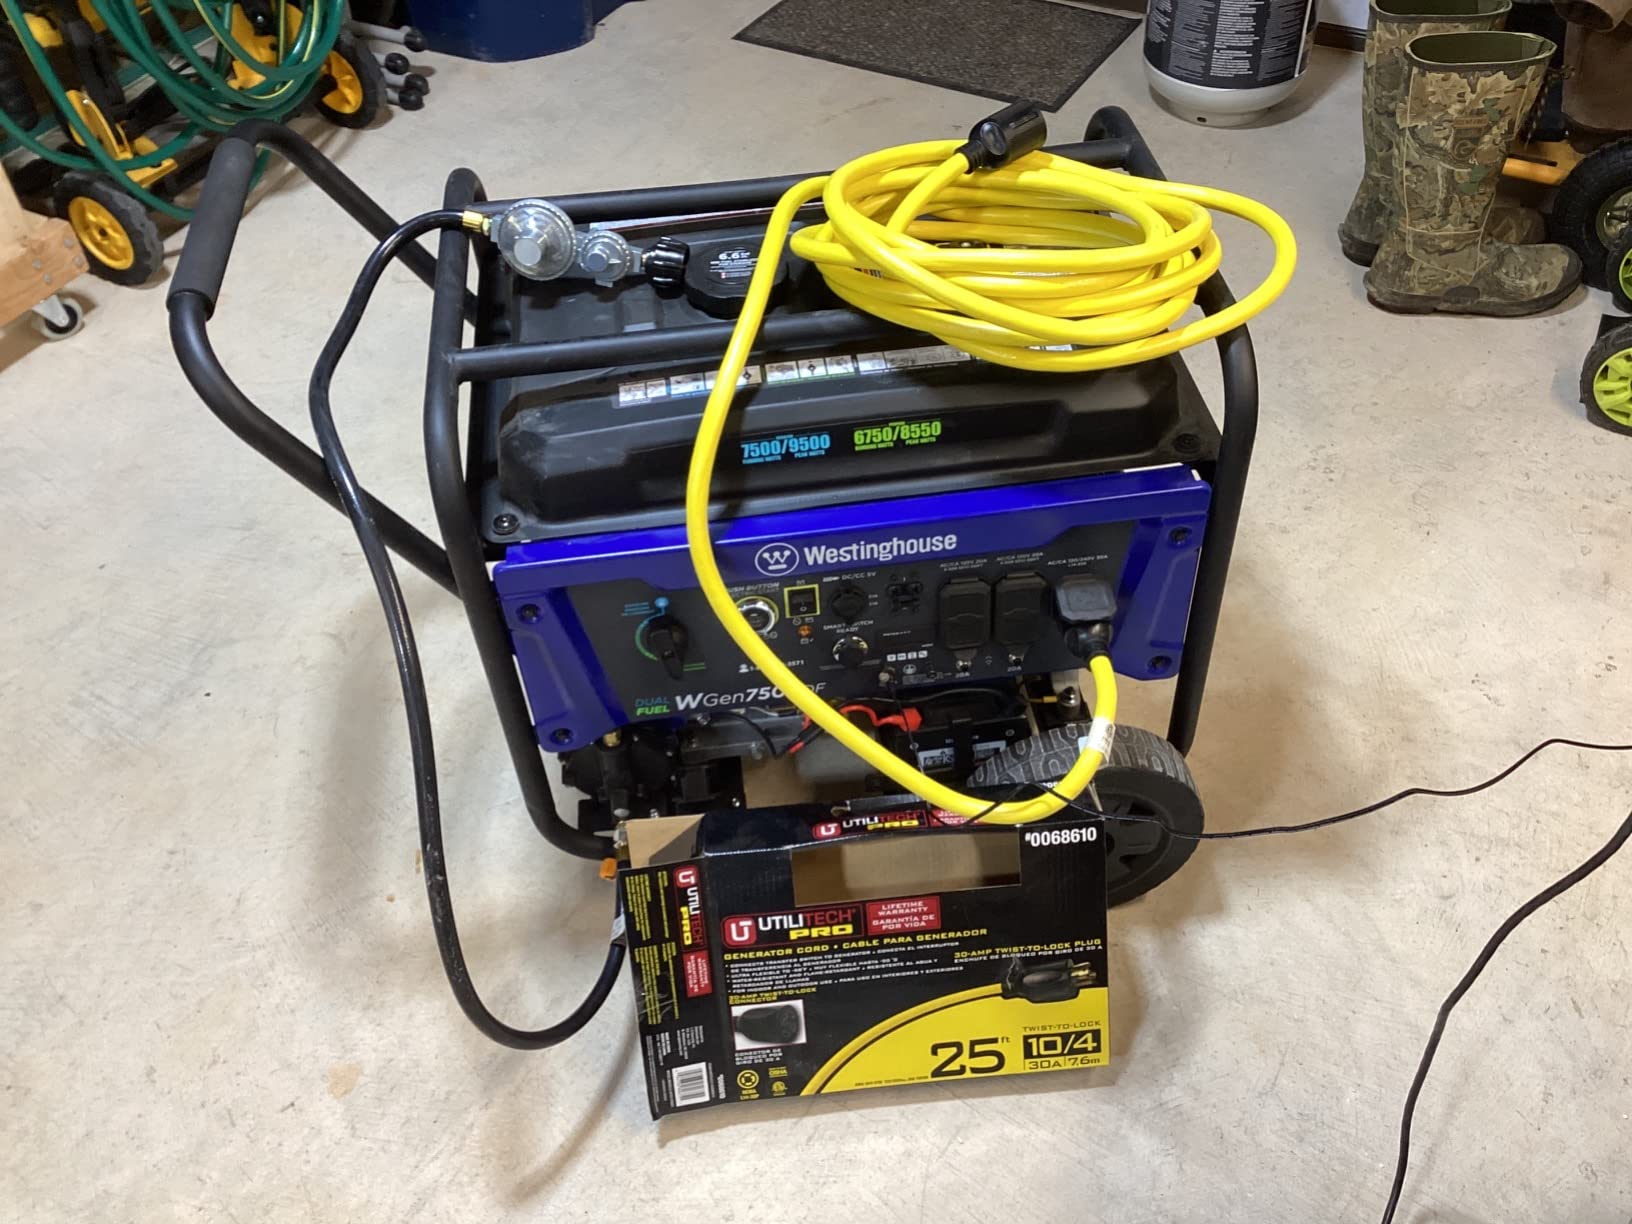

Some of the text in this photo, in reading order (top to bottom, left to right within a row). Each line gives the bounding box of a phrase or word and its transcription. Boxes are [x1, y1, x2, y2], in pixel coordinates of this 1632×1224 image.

[718, 252, 740, 260] 6.6
[854, 421, 942, 445] 6750/8550
[740, 434, 831, 458] 7500/9500
[803, 533, 957, 567] Westinghouse
[635, 696, 670, 708] DUAL
[636, 705, 671, 716] FUEL
[867, 818, 920, 831] PRO
[1024, 826, 1097, 848] #0068610
[877, 906, 929, 917] WARRANTY
[881, 900, 924, 911] LIFETIME
[680, 905, 692, 946] PRO
[872, 913, 936, 926] GARANTÍA DE
[882, 920, 928, 930] POR VIDA
[789, 923, 854, 941] PRO
[842, 928, 988, 950] CABLE PARA GENERADOR
[916, 941, 960, 950] INTERRUPTOR
[954, 938, 1102, 959] 30-AMP TWIST-TO-LOCK PLUG
[723, 944, 830, 961] GENERATOR CORD
[954, 954, 988, 963] ENCHUFE
[1001, 951, 1036, 959] BLOQUEO
[759, 987, 817, 997] TWIST-TO-LOCK
[728, 996, 778, 1005] CONNECTOR
[1022, 1020, 1102, 1033] TWIST-TO-LOCK
[1000, 1035, 1010, 1044] ft
[1027, 1032, 1098, 1056] 10/4
[735, 1049, 771, 1057] CONECTOR
[930, 1037, 1006, 1079] 25
[1028, 1059, 1063, 1070] 30A
[1067, 1055, 1101, 1067] 7.6m
